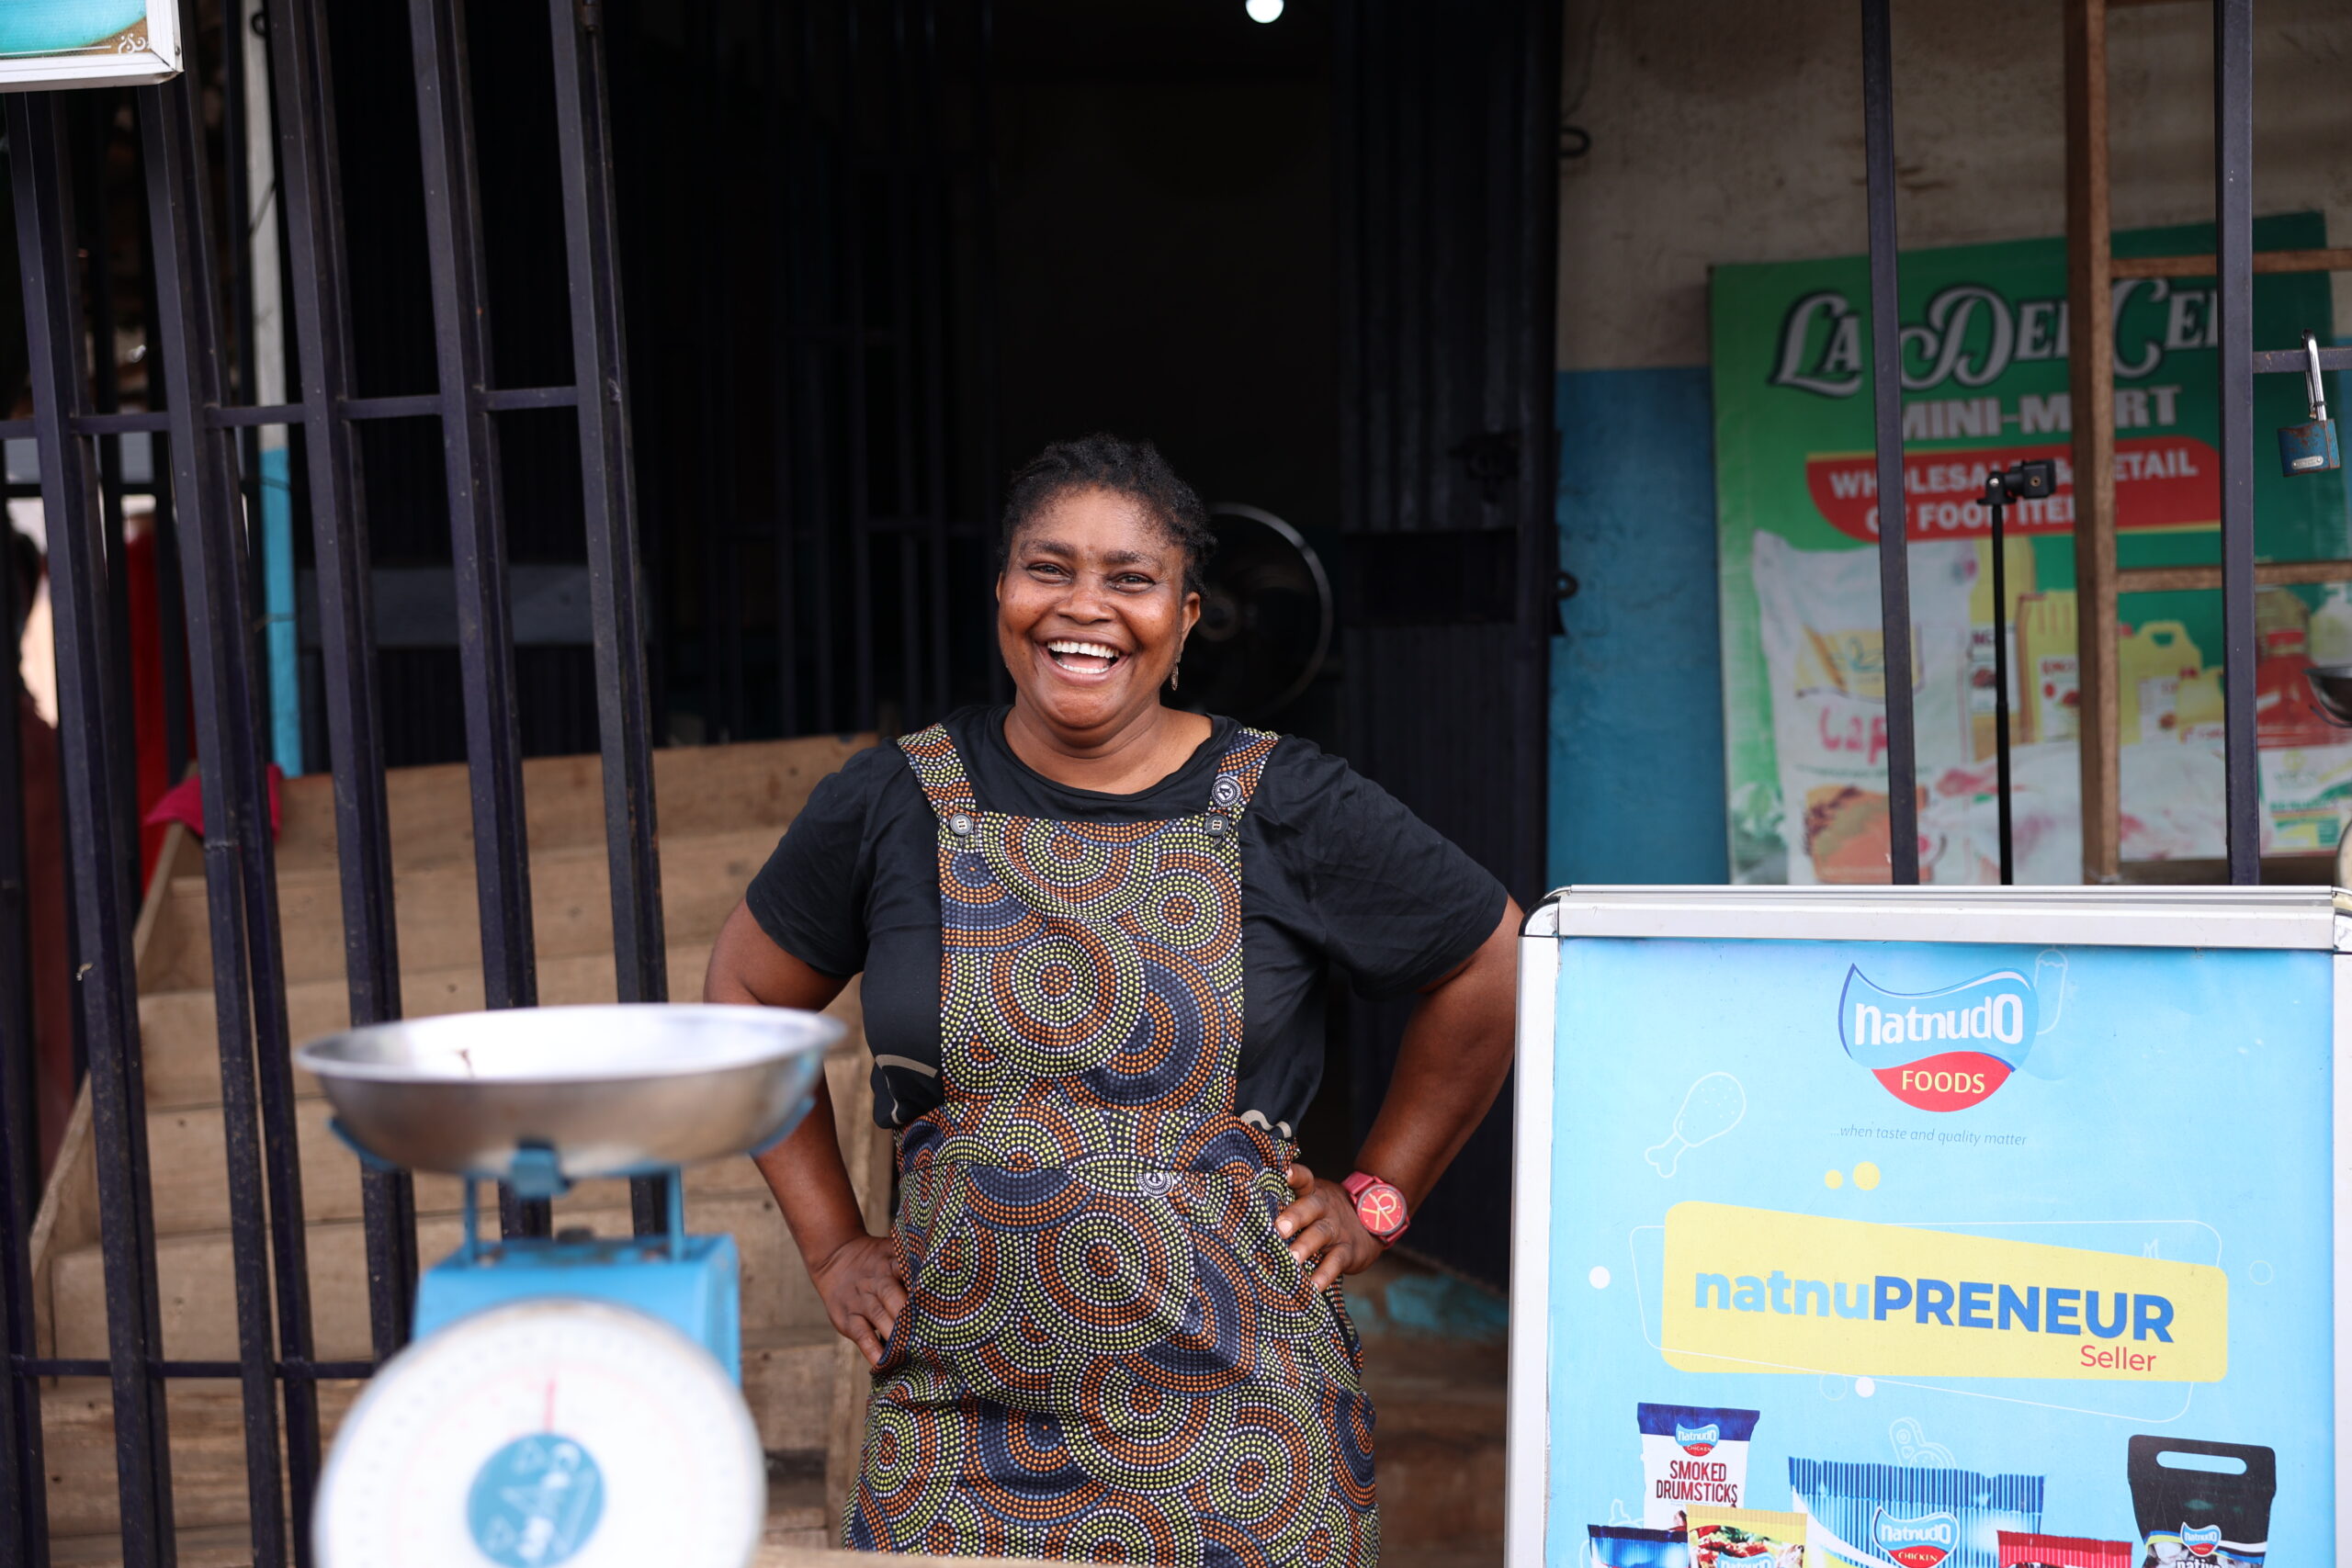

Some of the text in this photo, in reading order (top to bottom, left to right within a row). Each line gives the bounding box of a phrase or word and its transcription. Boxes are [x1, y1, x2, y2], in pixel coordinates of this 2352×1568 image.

[1902, 385, 2181, 440] INI-MRT
[2115, 447, 2199, 482] ETAIL
[1901, 1069, 1986, 1095] FOODS
[1875, 1125, 1907, 1140] taste
[1910, 1128, 1935, 1142] and
[1938, 1129, 1982, 1147] quality
[1984, 1134, 2028, 1146] matter
[1695, 1269, 2175, 1344] natnuPRENEUR
[2080, 1344, 2157, 1372] Seller
[1669, 1460, 1727, 1482] SMOKED
[1656, 1479, 1738, 1504] DRUMSTICKS
